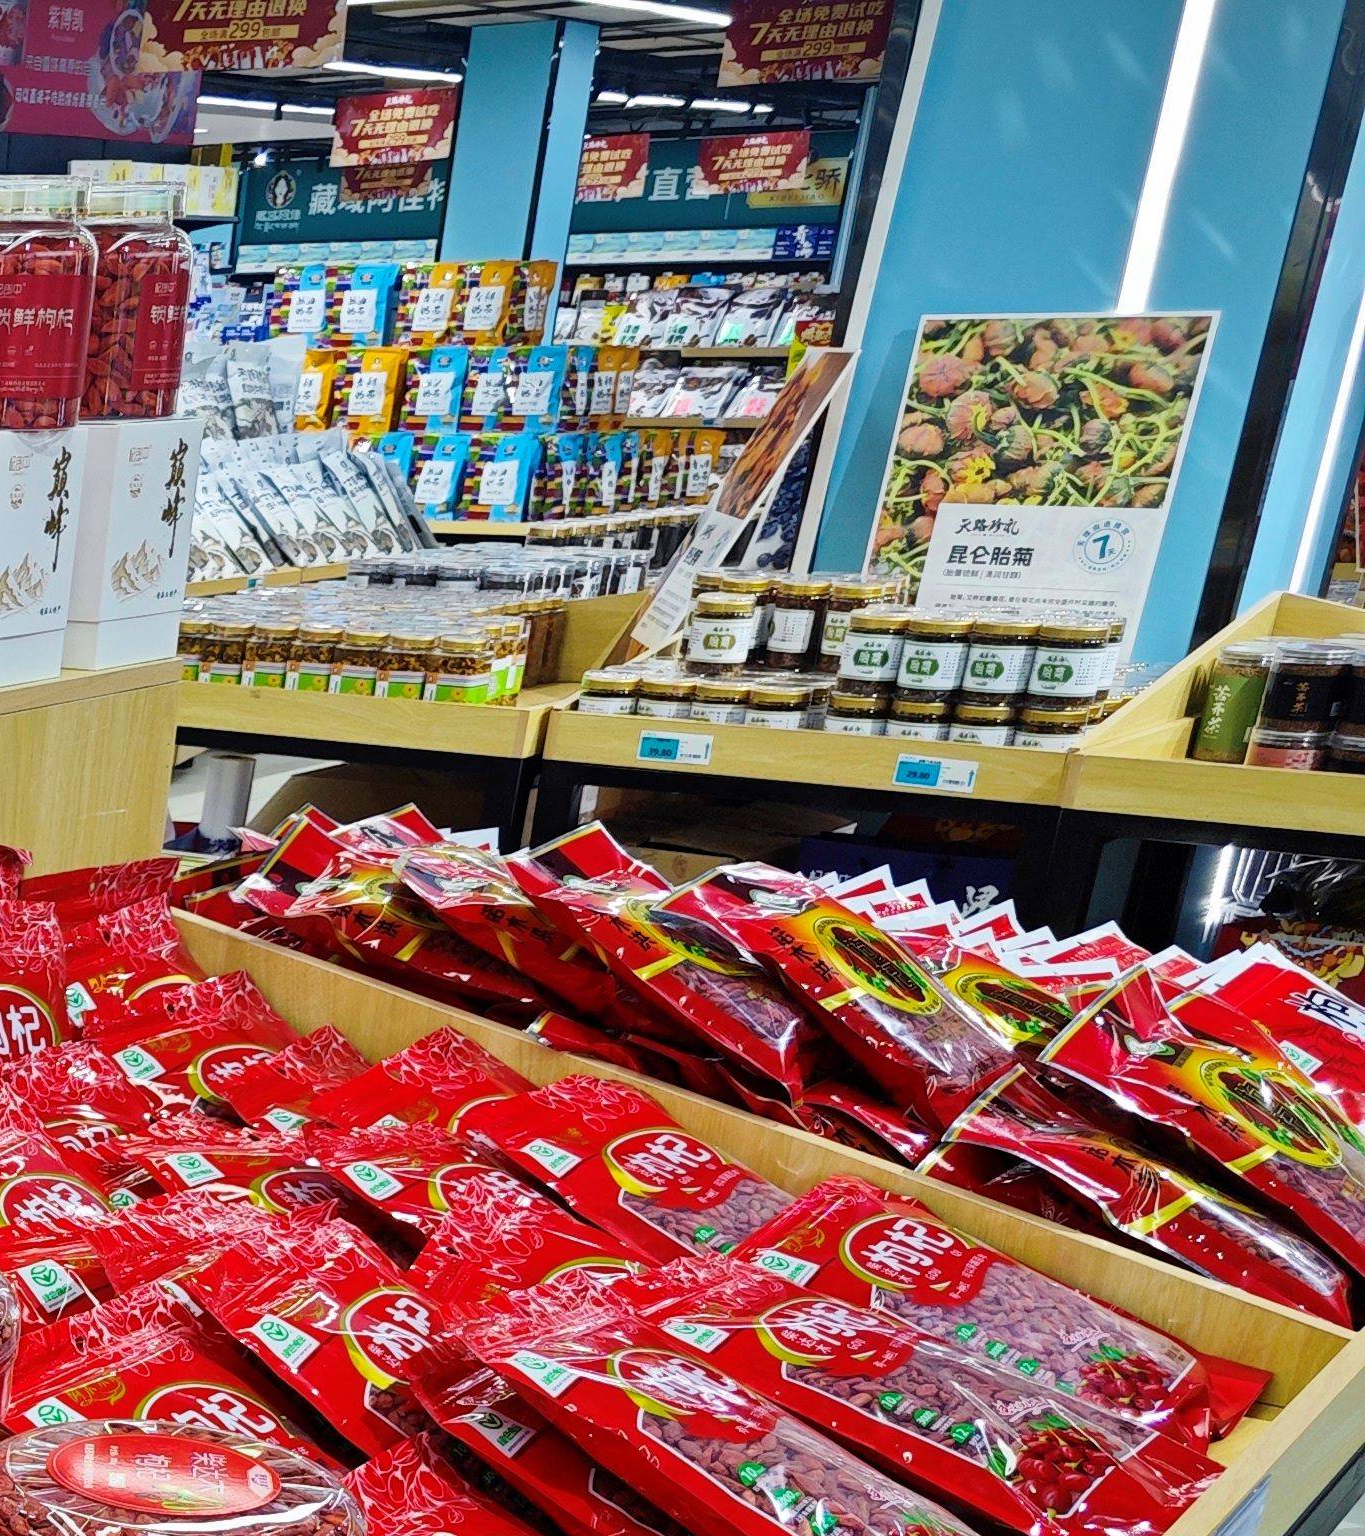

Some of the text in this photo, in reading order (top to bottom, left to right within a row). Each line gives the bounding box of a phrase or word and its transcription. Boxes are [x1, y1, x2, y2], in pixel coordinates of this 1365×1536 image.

[778, 1, 884, 24] 全场免费试吃
[749, 21, 875, 46] 7天无理由退换
[955, 517, 1020, 535] 天路珍礼
[946, 544, 1035, 567] 昆仑胎菊
[1092, 534, 1111, 560] 7
[906, 770, 930, 780] 29.80
[625, 1133, 712, 1188] 枸杞
[868, 1217, 956, 1284] 枸杞
